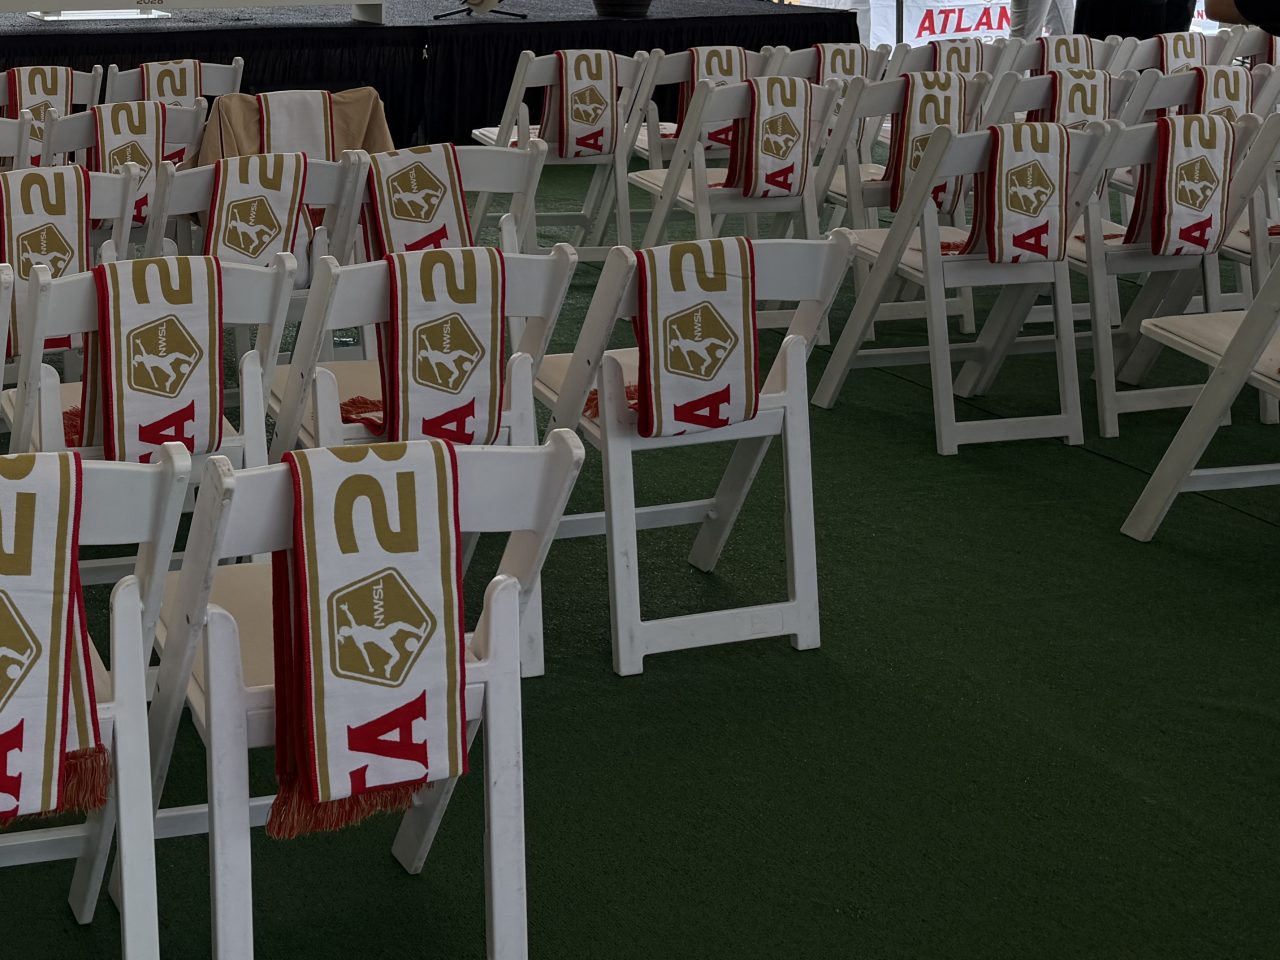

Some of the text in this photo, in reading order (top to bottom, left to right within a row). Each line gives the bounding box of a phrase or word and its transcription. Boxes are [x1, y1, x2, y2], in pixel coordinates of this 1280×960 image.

[410, 167, 419, 192] NWSL
[249, 200, 257, 225] NWSL
[158, 322, 167, 357] NWSL
[443, 321, 451, 353] NWSL
[693, 308, 702, 342] NWSL
[373, 578, 385, 628] NWSL
